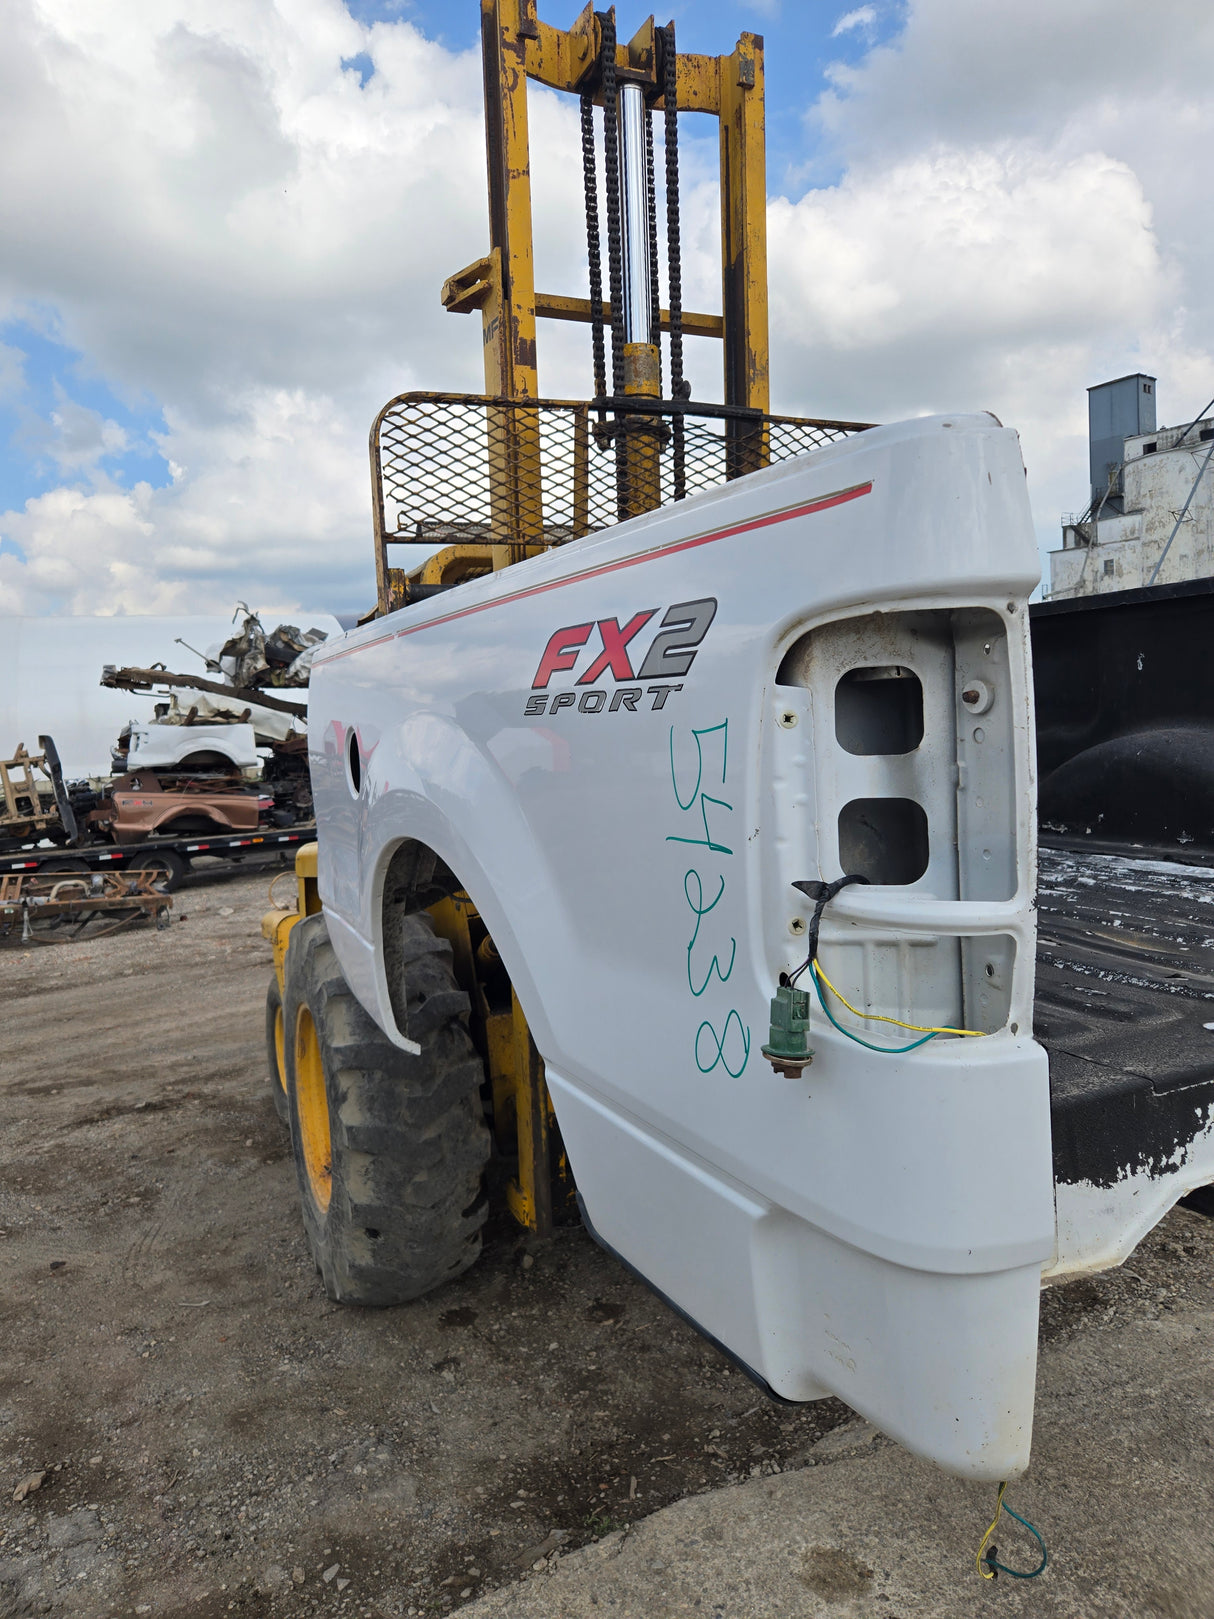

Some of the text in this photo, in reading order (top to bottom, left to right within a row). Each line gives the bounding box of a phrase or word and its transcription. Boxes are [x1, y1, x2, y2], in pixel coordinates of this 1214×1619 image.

[531, 597, 718, 690] FX2
[524, 683, 683, 716] SPORT
[666, 717, 751, 1079] 54238
